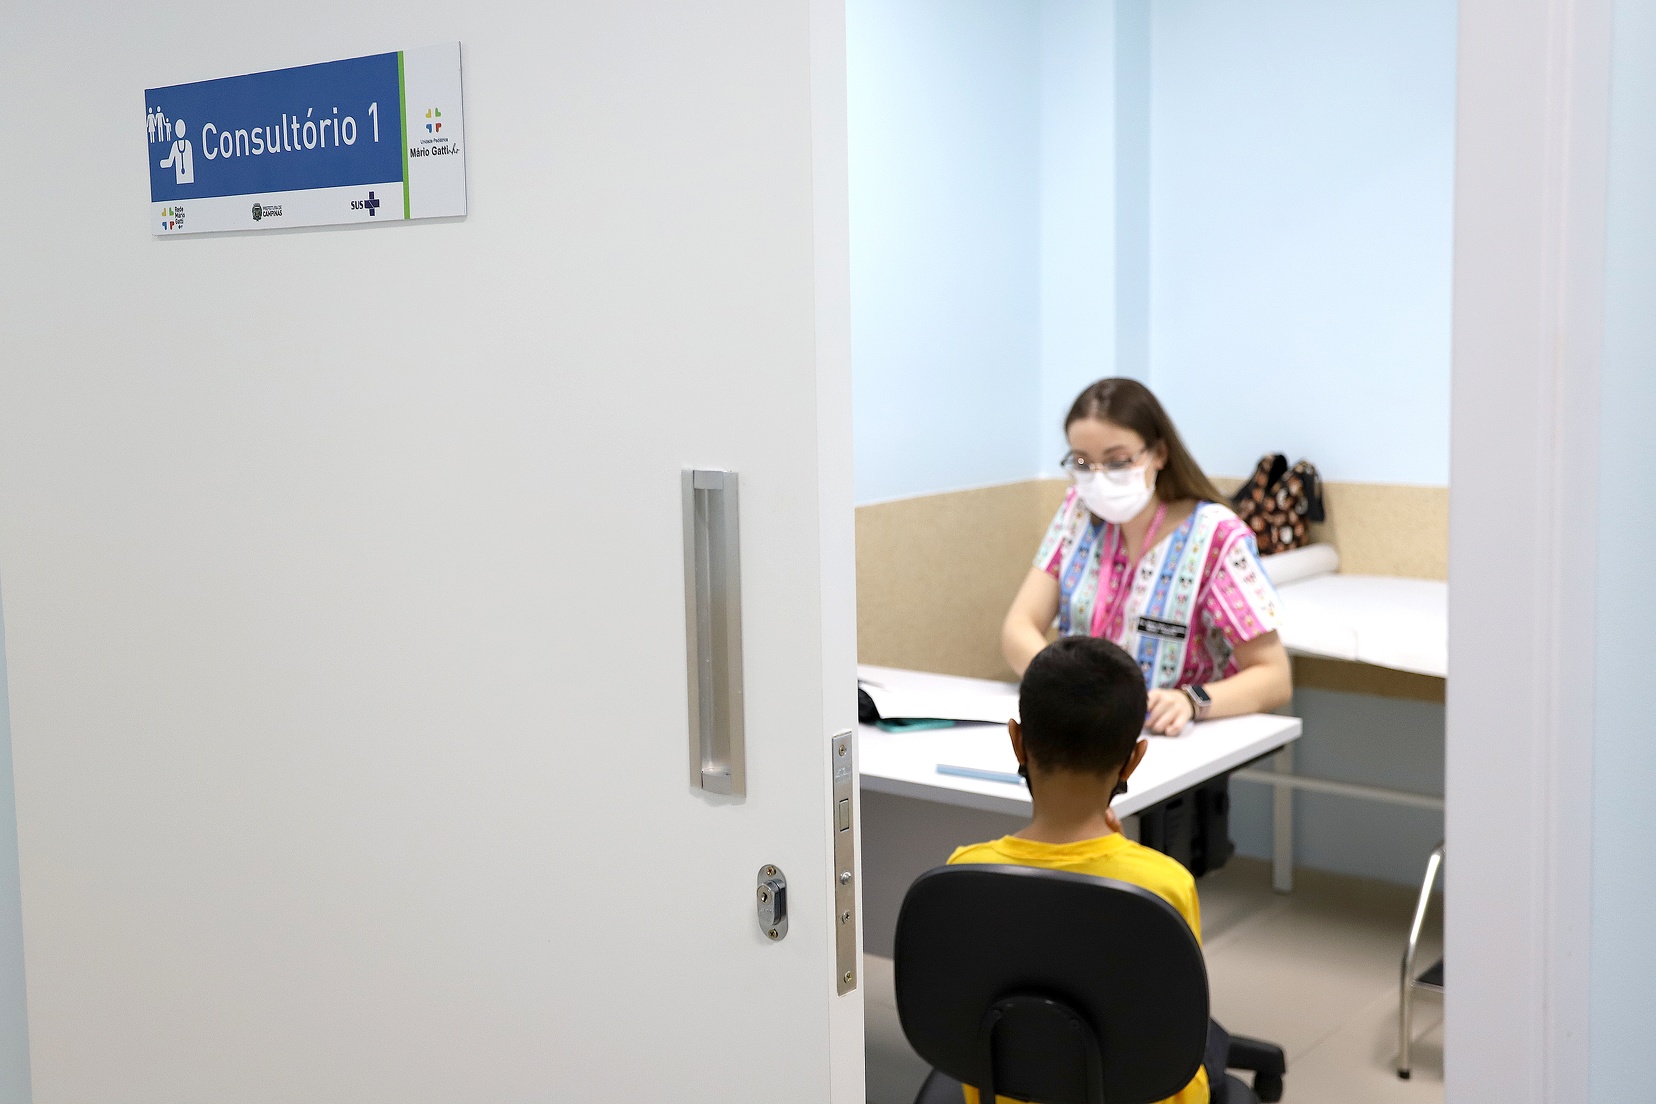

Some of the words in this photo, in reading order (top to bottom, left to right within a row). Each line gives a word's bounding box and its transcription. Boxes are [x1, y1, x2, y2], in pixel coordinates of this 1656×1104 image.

[202, 107, 357, 160] Consultório
[368, 101, 379, 143] 1
[410, 147, 430, 158] Mário
[431, 145, 449, 156] Gatti
[350, 200, 364, 210] SUS
[262, 209, 283, 217] CAMPINAS
